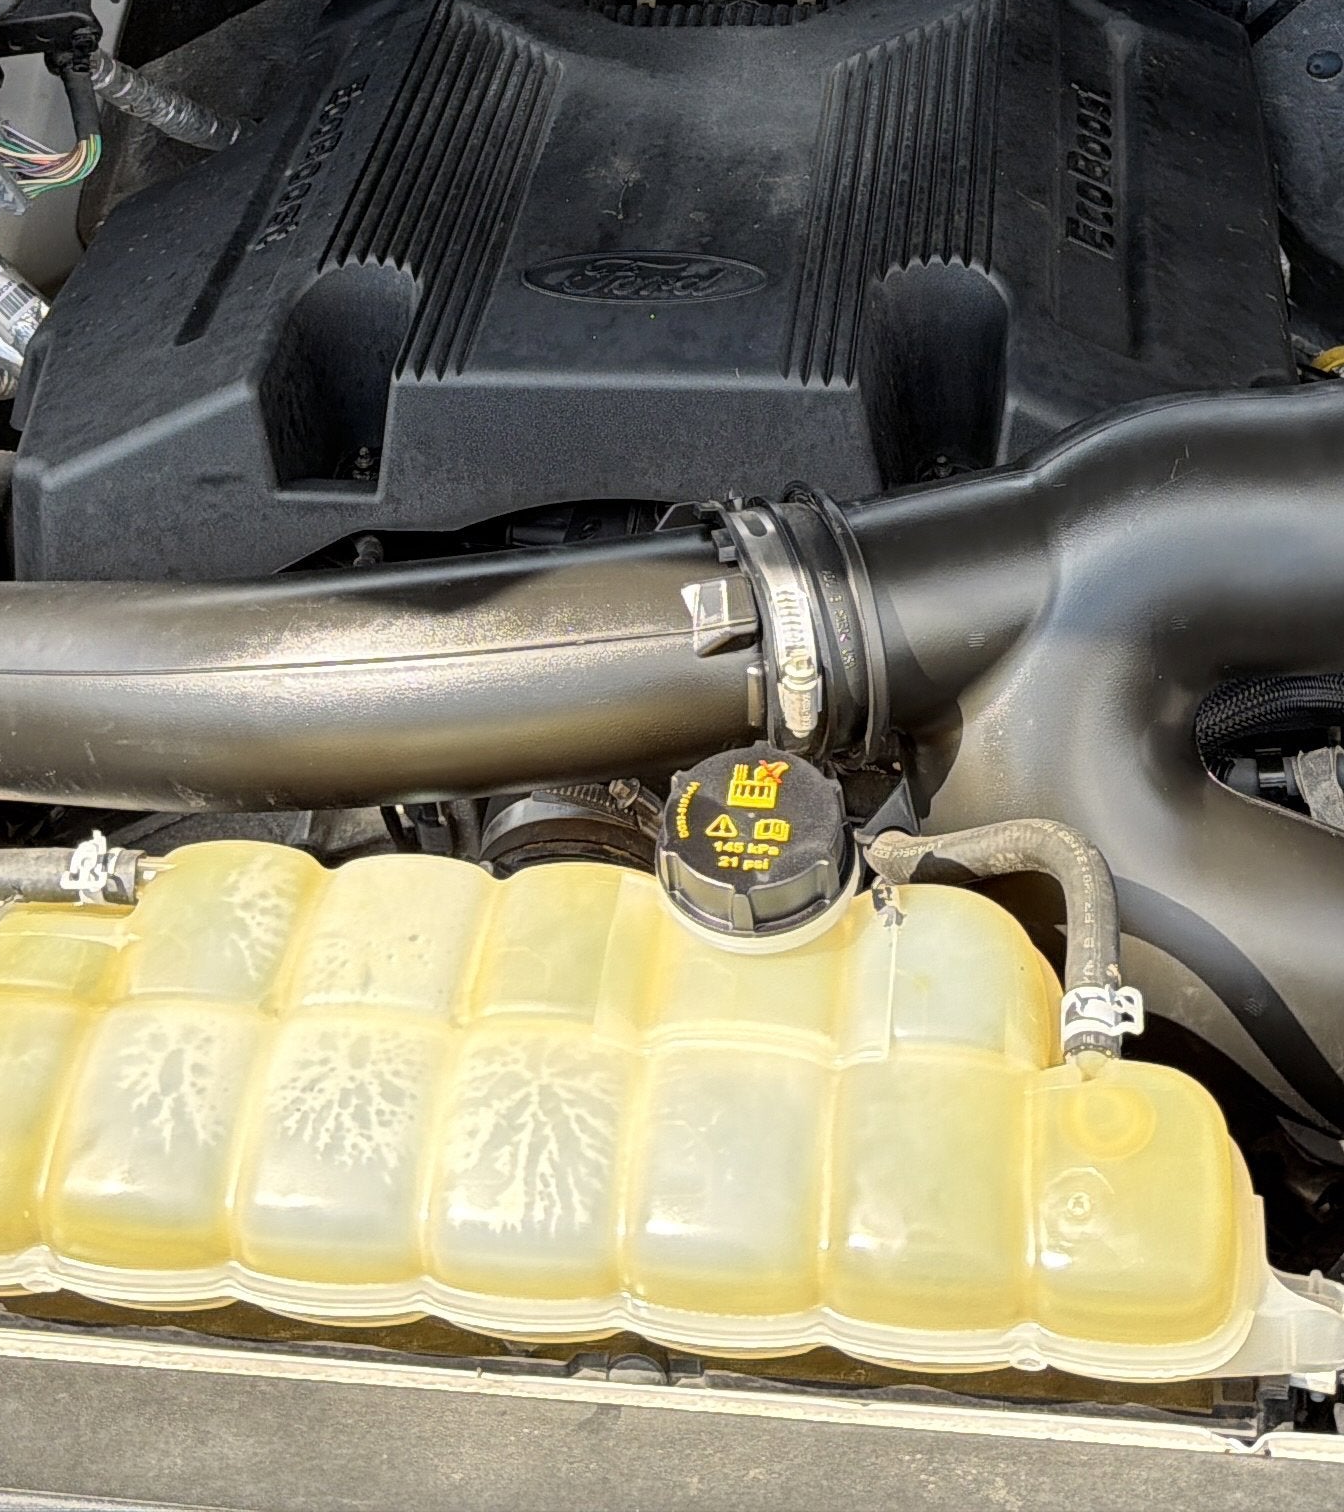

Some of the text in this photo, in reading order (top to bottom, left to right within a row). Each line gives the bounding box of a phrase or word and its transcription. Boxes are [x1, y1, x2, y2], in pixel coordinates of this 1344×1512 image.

[1066, 82, 1115, 259] EcoBoost
[544, 257, 732, 298] Ford
[713, 841, 779, 856] 145 kPa
[717, 855, 769, 871] 21 psi
